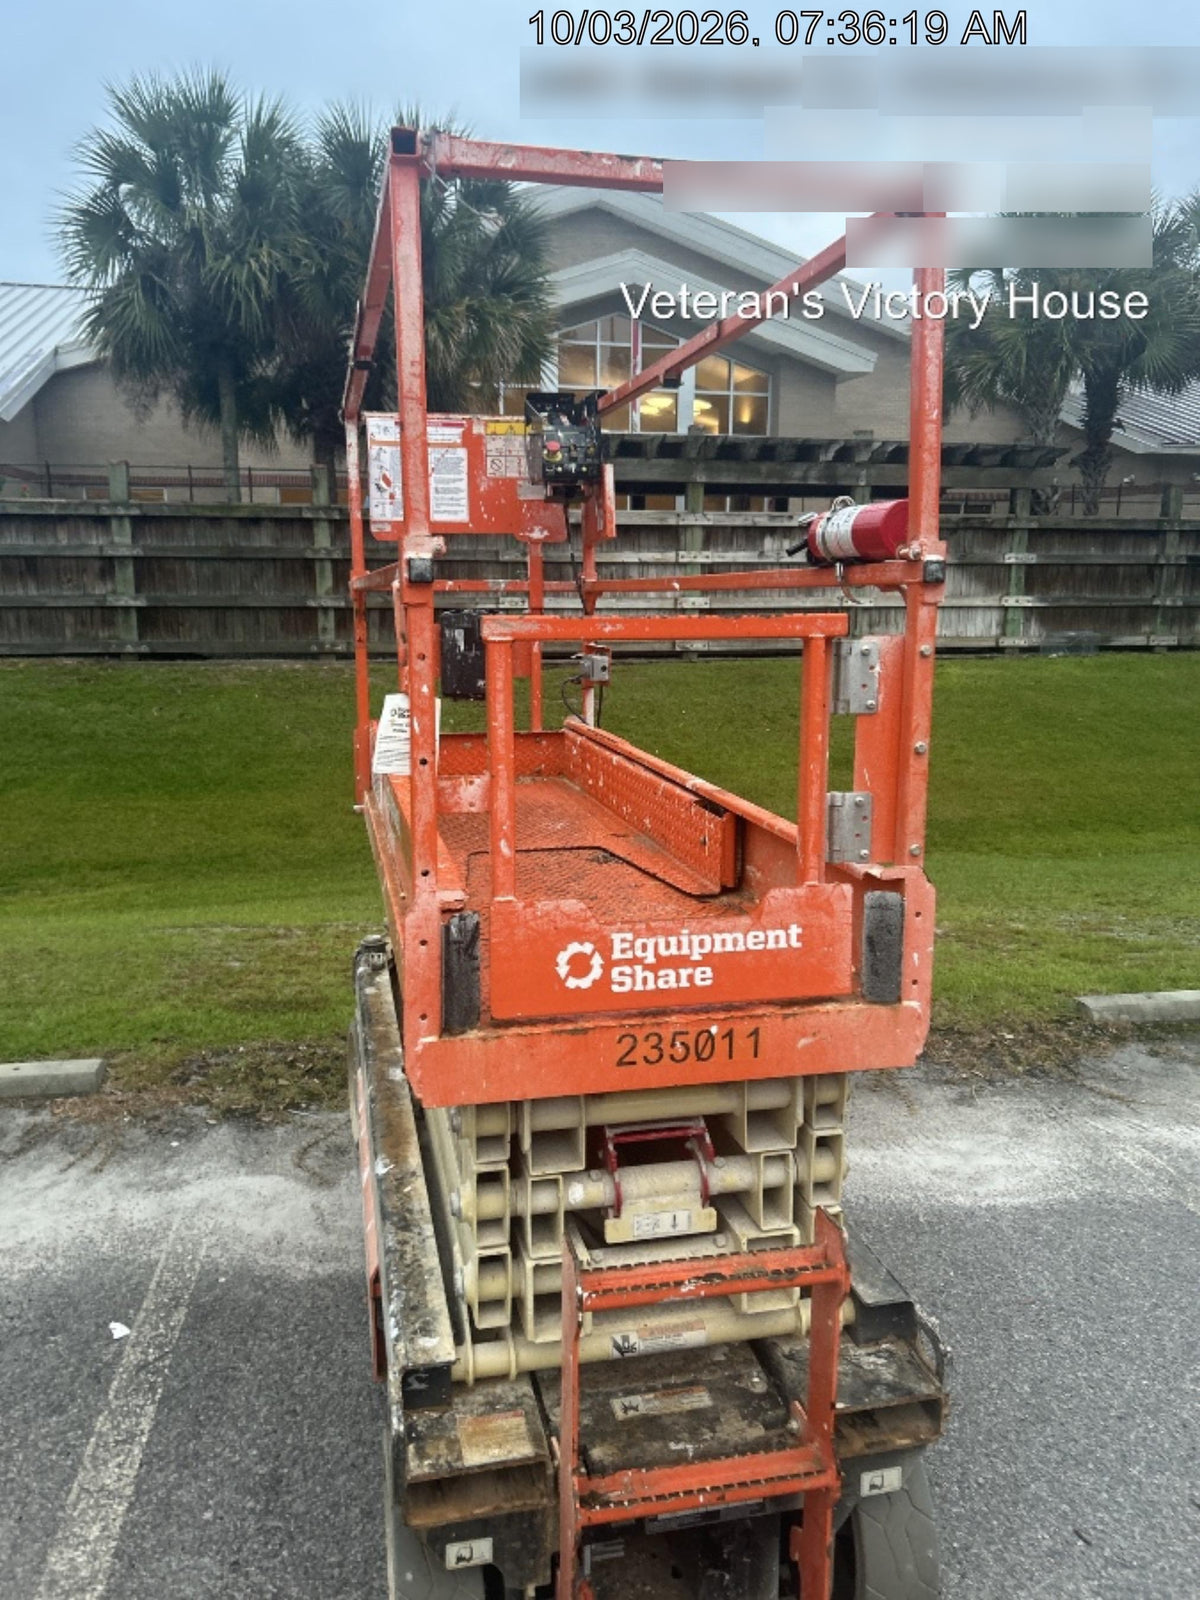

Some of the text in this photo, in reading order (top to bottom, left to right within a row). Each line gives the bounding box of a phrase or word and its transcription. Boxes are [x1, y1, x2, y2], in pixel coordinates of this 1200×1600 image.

[610, 923, 803, 964] Equipment
[610, 965, 714, 993] Share
[615, 1026, 761, 1067] 235011
